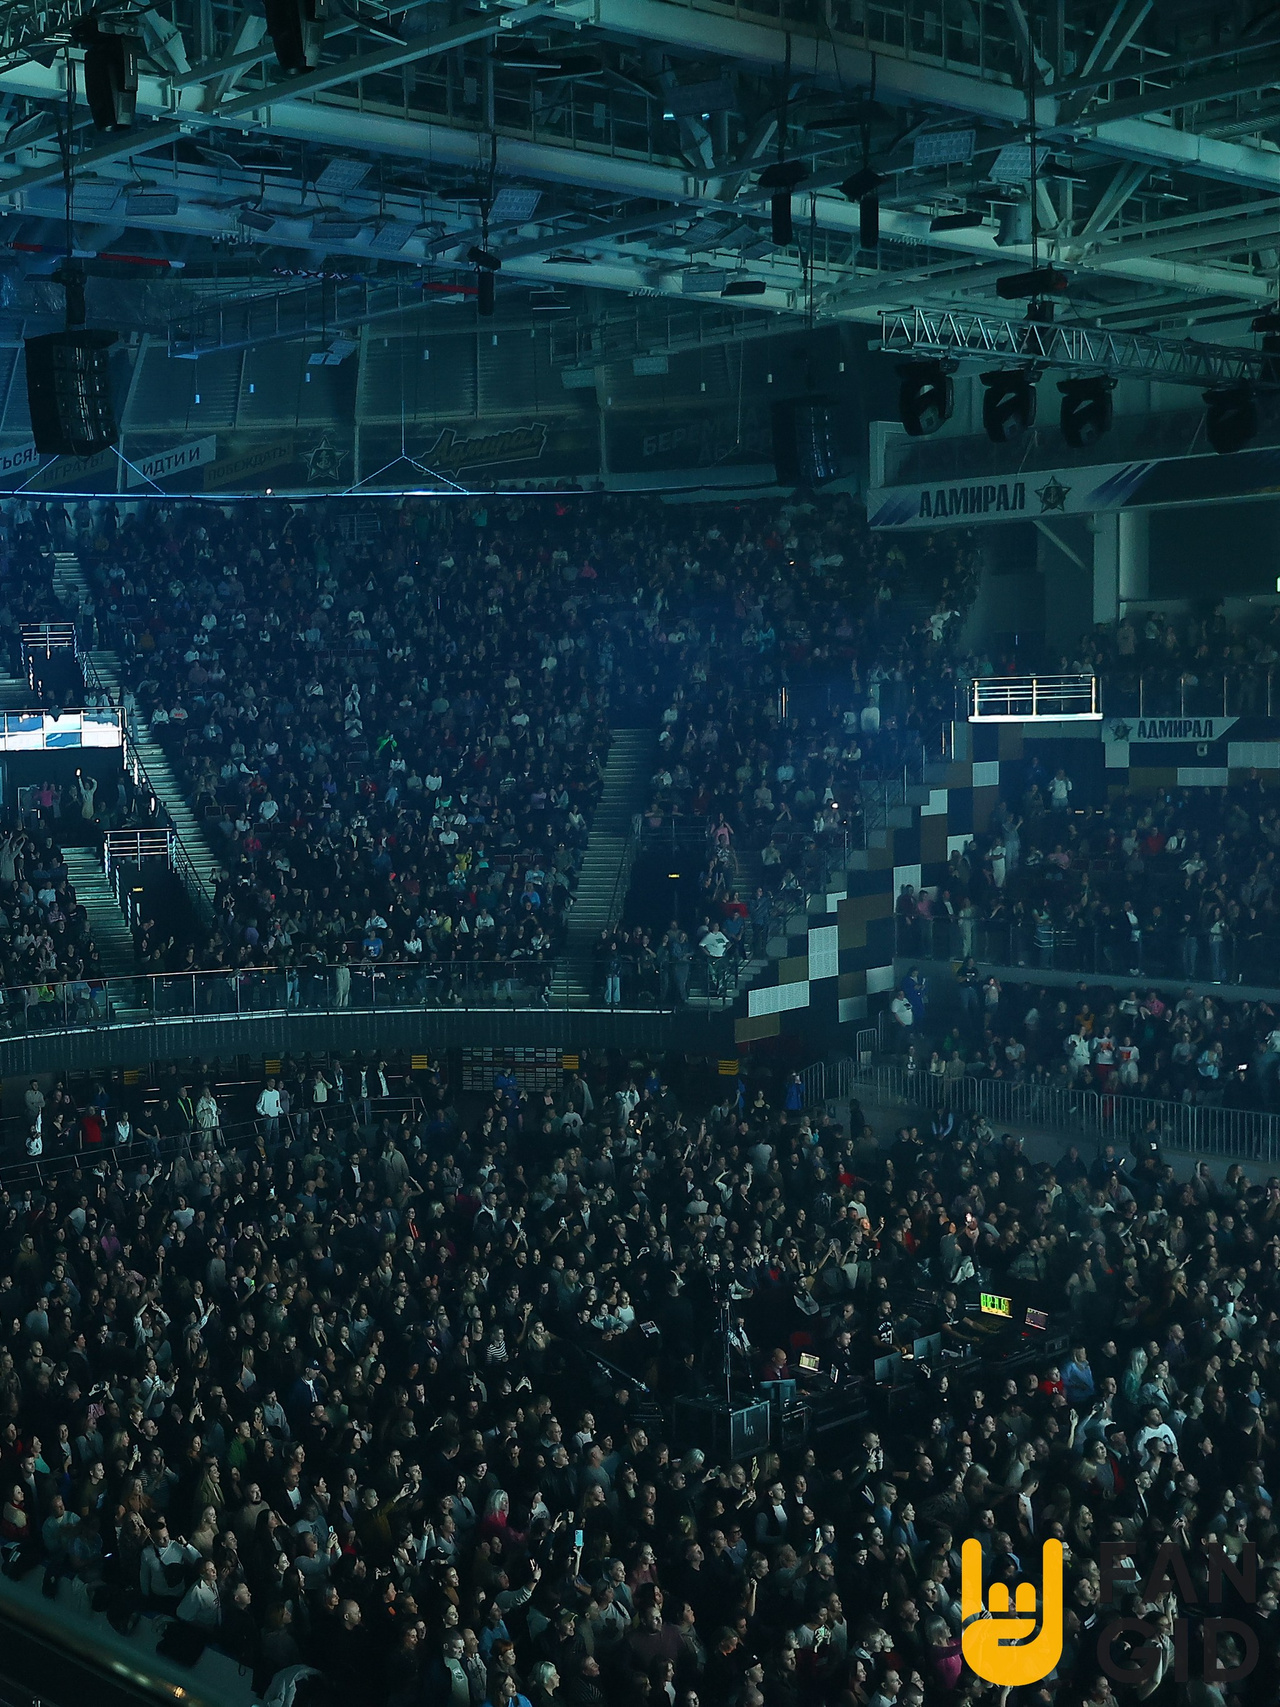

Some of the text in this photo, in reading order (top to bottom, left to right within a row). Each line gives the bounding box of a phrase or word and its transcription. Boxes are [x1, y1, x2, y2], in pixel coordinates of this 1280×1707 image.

[142, 446, 200, 477] ИДТИ И
[918, 482, 1026, 518] АДМИРАЛ
[1137, 719, 1214, 739] АДМИРАЛ
